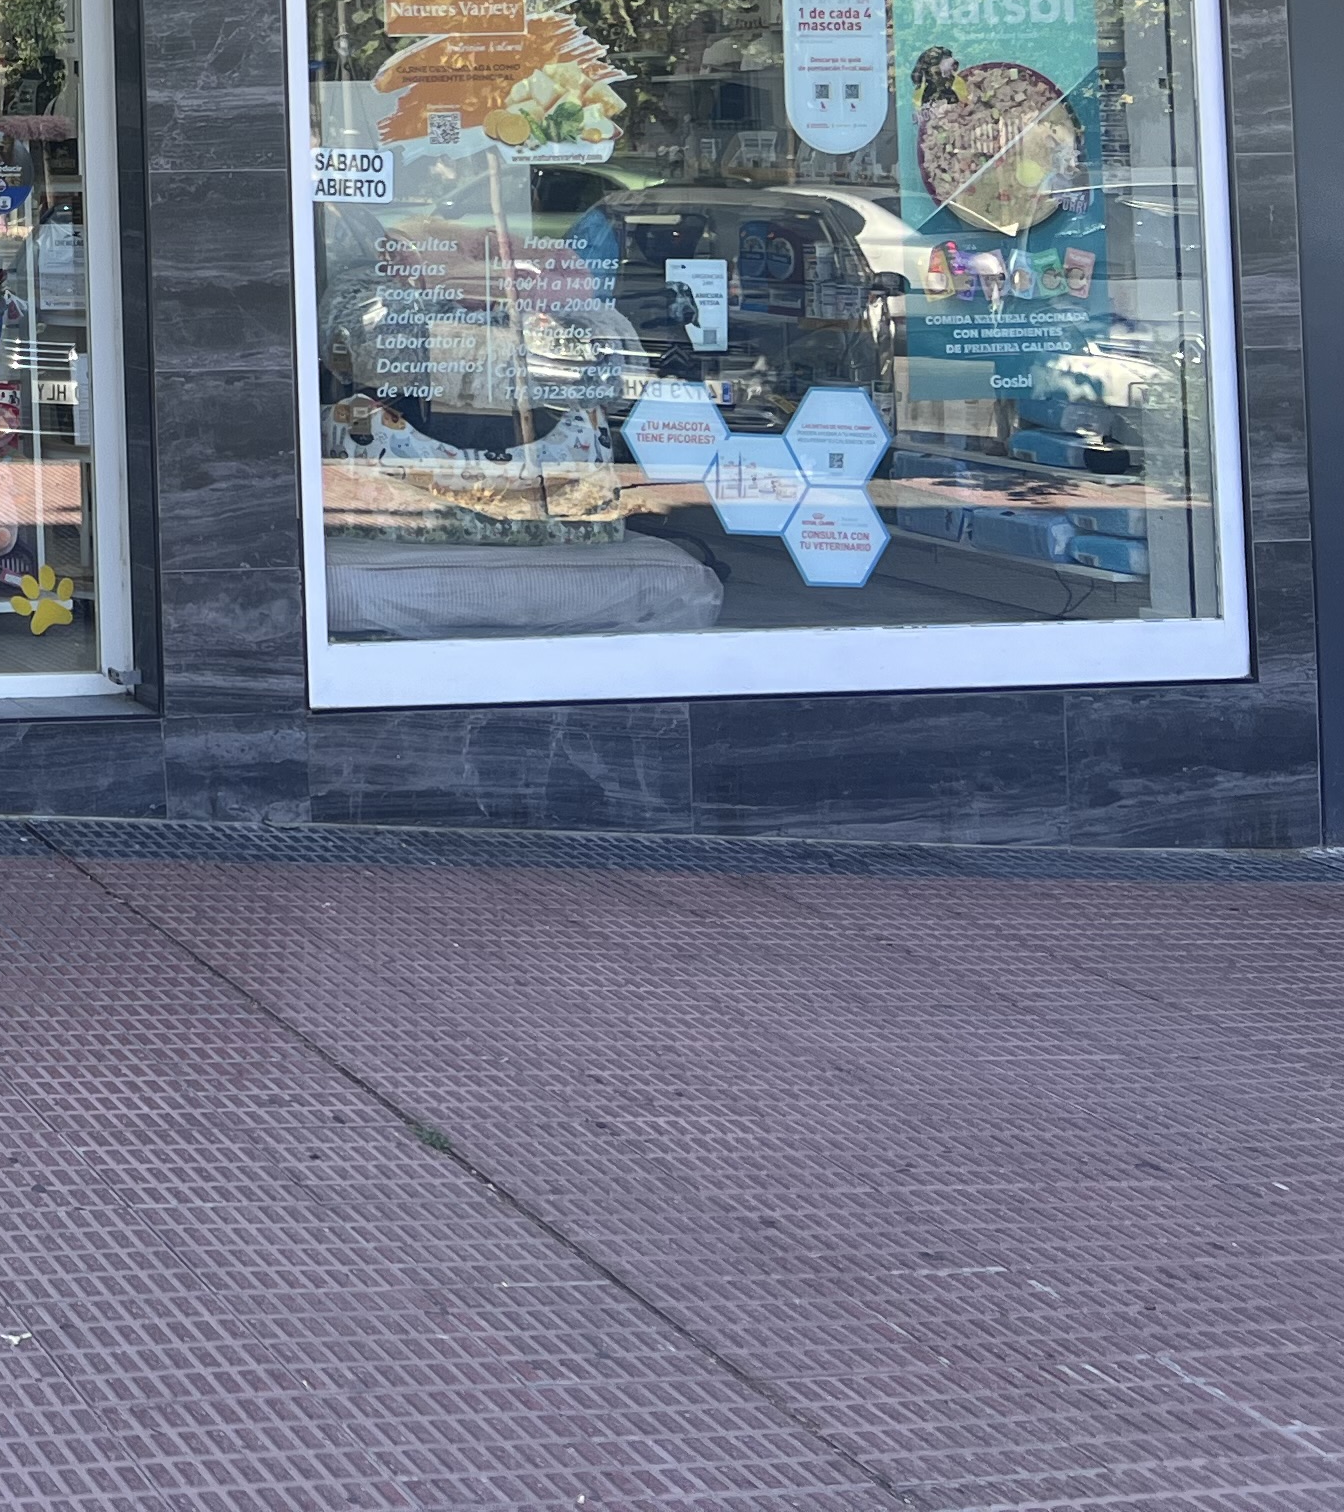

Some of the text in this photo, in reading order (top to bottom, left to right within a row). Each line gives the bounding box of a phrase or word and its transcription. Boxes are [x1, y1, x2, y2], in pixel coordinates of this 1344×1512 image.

[459, 0, 520, 19] Variety
[799, 8, 872, 19] 1 de cada 4
[798, 21, 862, 31] mascotas
[315, 152, 383, 173] SÁBADO
[315, 179, 386, 198] ABIERTO
[375, 237, 458, 252] Consultas
[524, 236, 588, 249] Horario
[545, 256, 619, 269] a viernes
[375, 261, 446, 279] Cirugías
[537, 277, 547, 289] H
[552, 280, 561, 290] a
[566, 277, 600, 289] 14:00
[604, 277, 615, 289] H
[536, 298, 615, 311] H a 20:00 H
[926, 315, 972, 325] COMIDA
[1029, 312, 1089, 324] COCINADA
[953, 327, 1062, 338] CON INGREDIENTES
[376, 333, 476, 348] Laboratorio
[946, 341, 1071, 354] DE PRIMERA CALIDAD
[377, 359, 484, 373] Documentos
[990, 374, 1032, 388] Gosbi
[377, 382, 443, 401] de viaje
[532, 386, 615, 400] 912362664
[641, 420, 711, 432] ¿TU MASCOTA
[636, 432, 716, 445] TIENE PICORES?
[802, 530, 870, 541] CONSULTA CON
[800, 541, 871, 552] TU VETERINARIO
